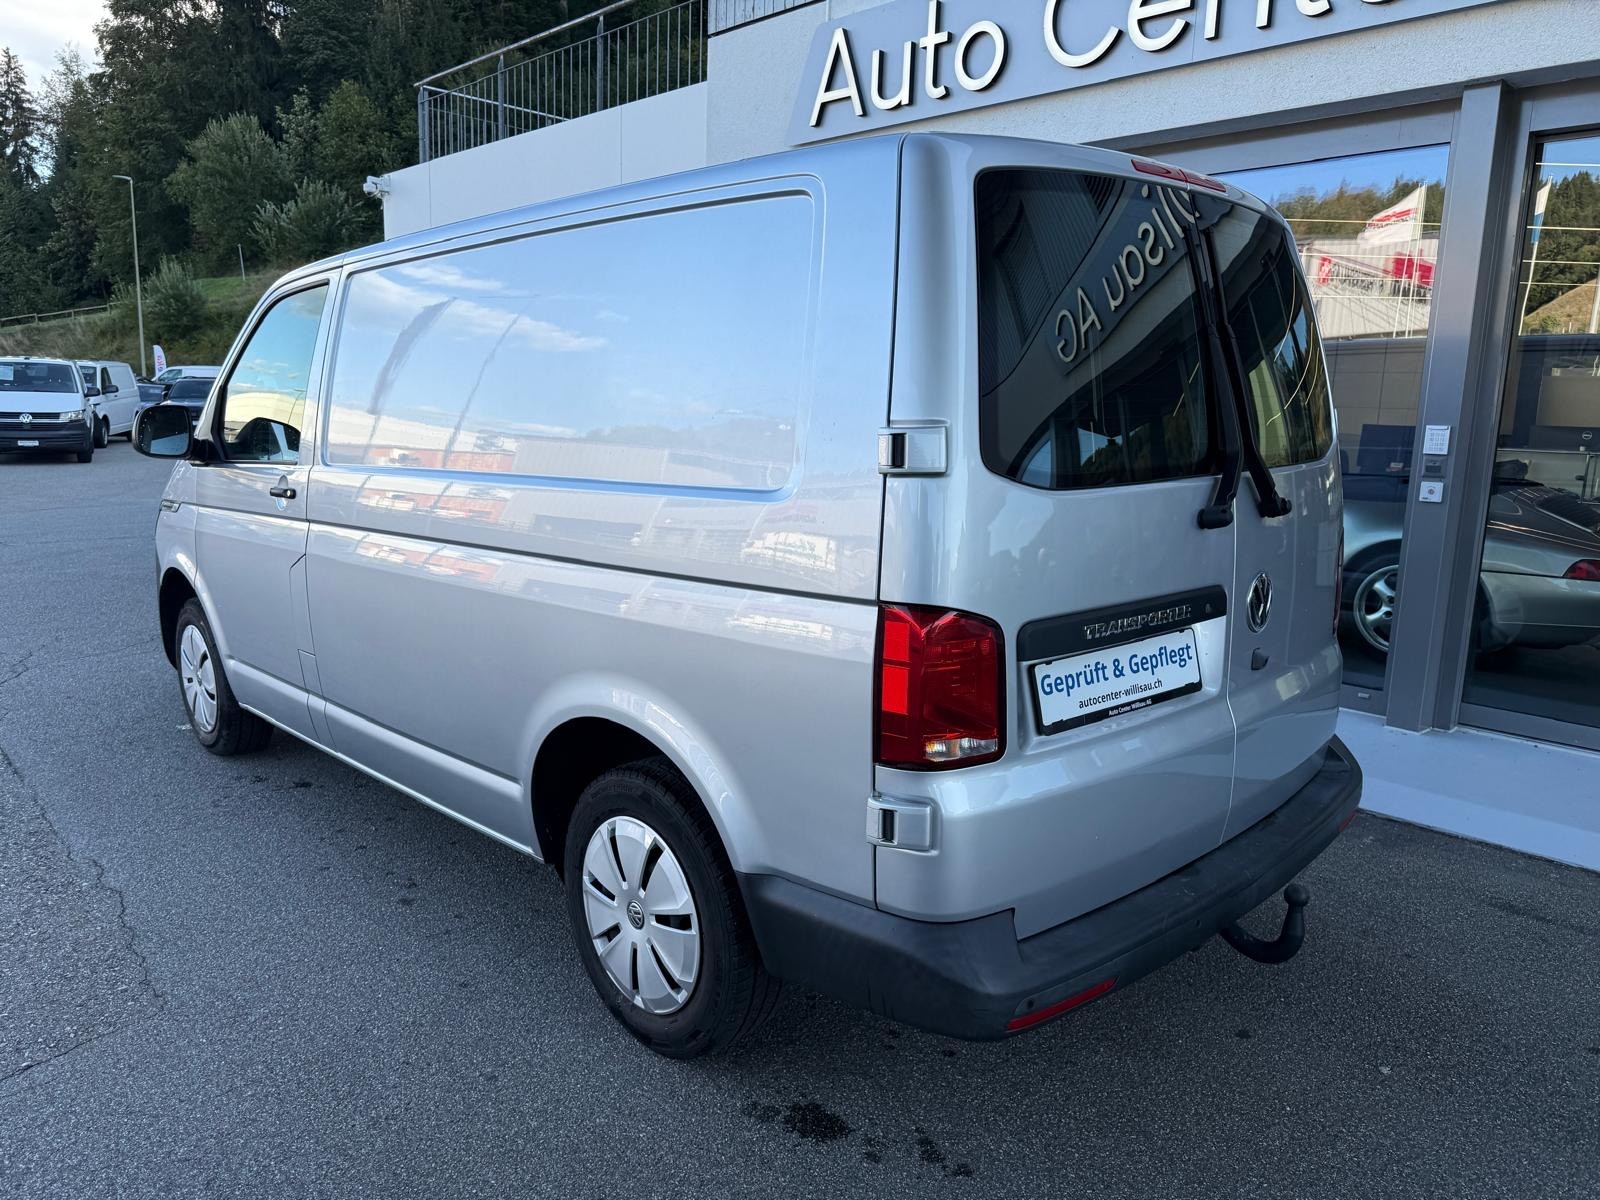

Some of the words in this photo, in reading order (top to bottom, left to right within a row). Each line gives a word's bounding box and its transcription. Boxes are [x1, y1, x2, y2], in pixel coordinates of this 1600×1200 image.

[809, 0, 1007, 127] Auto
[1085, 605, 1191, 639] TRANSPORTER
[1040, 661, 1109, 697] Geprüft
[1112, 658, 1125, 679] &
[1128, 643, 1193, 675] Gepflegt
[1078, 678, 1163, 709] autocenter-willisau.ch
